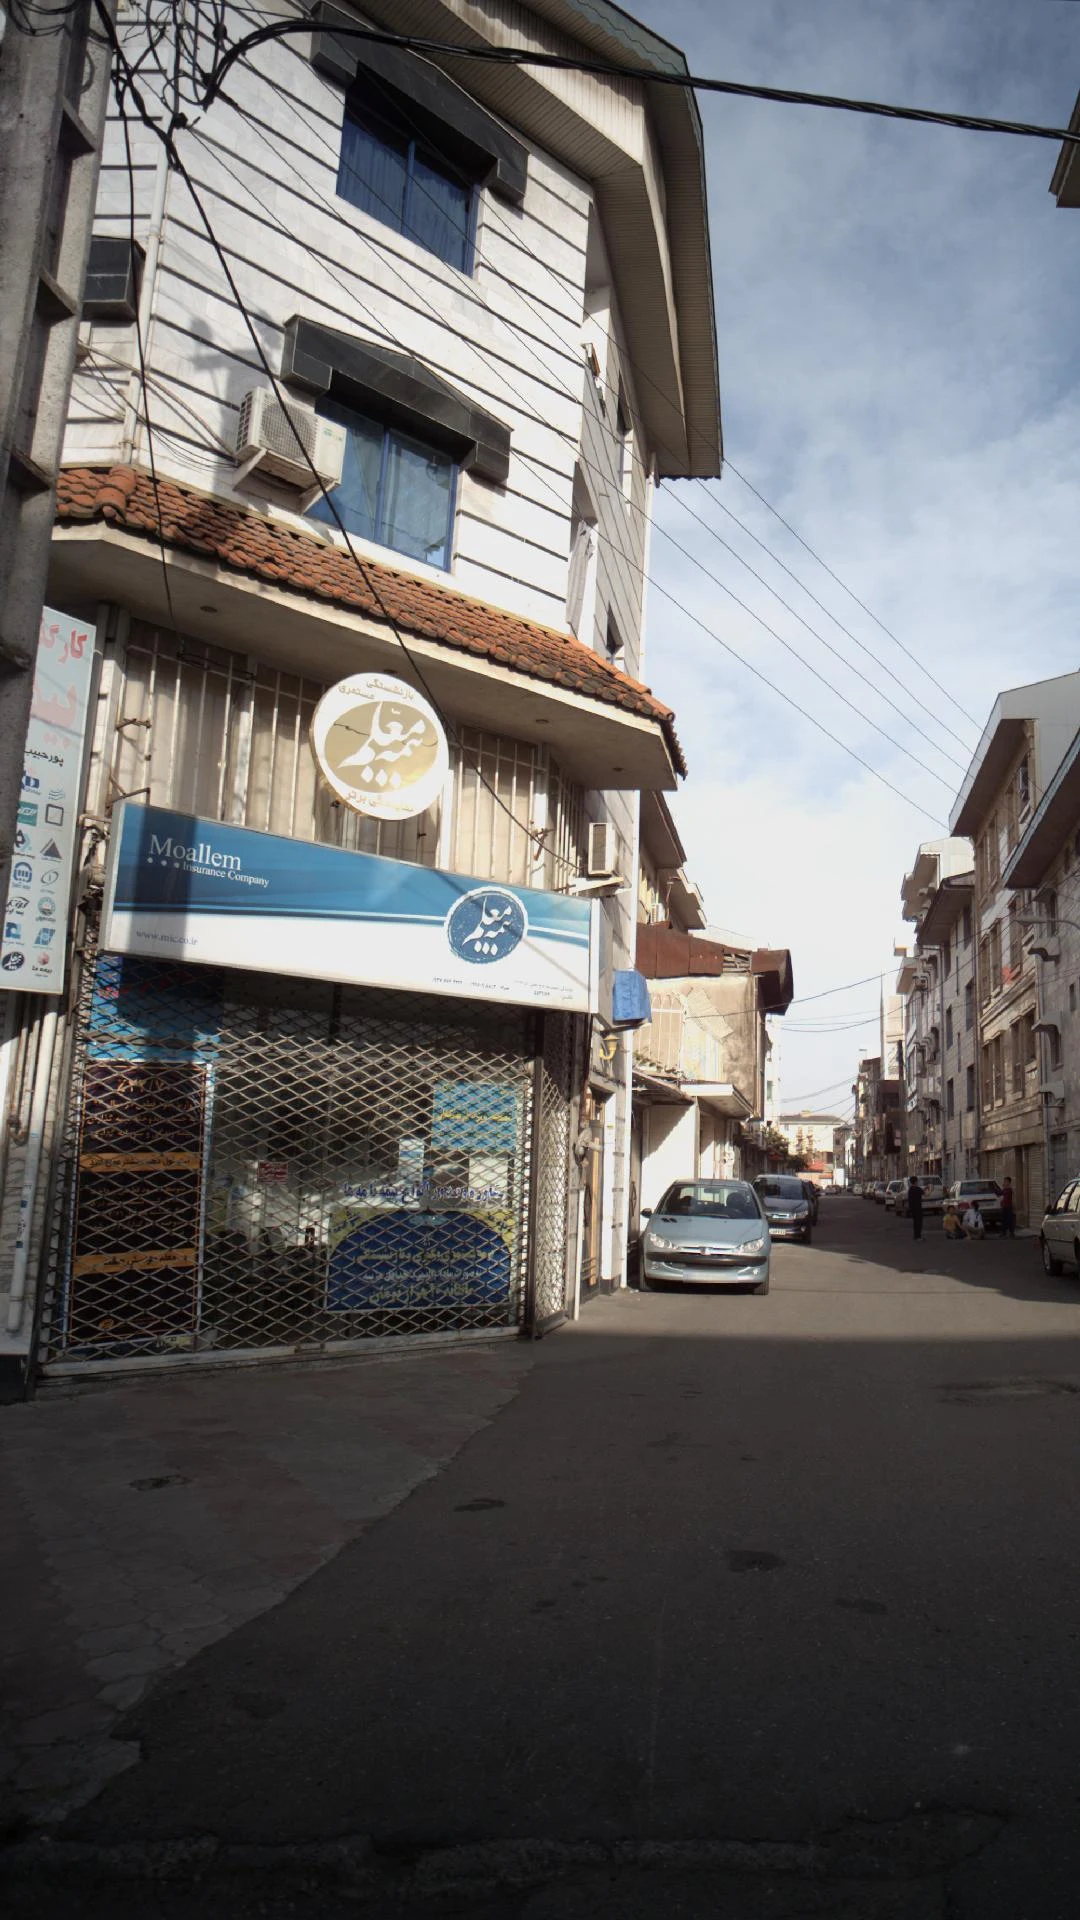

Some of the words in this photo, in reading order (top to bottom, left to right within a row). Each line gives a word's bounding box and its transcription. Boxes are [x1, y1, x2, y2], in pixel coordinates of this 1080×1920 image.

[149, 834, 242, 871] Moallem
[183, 861, 226, 878] Insurance
[227, 870, 270, 888] Company
